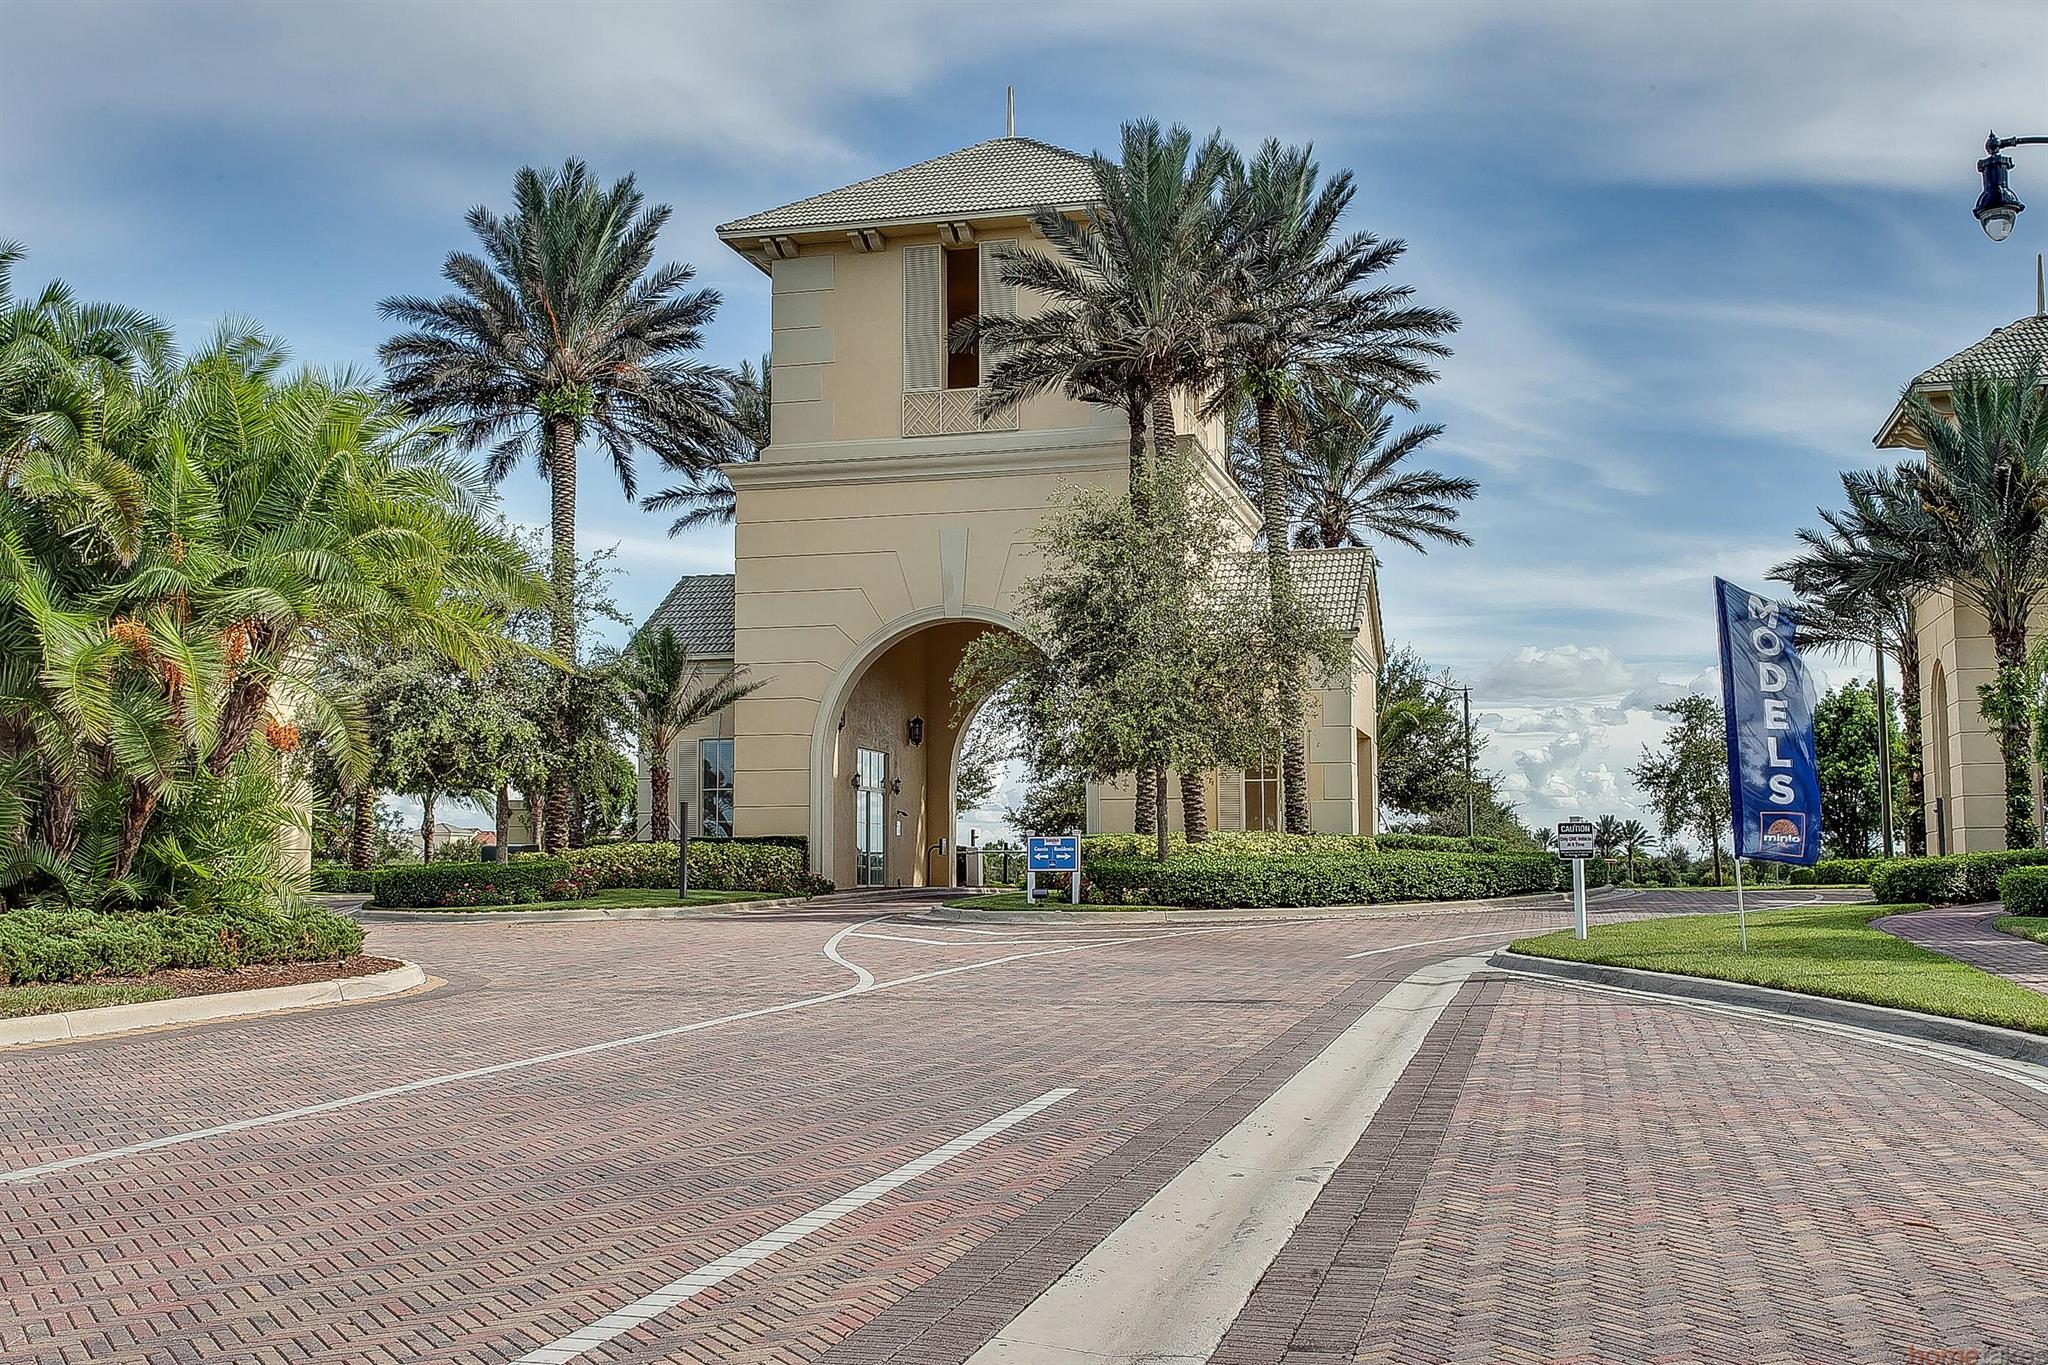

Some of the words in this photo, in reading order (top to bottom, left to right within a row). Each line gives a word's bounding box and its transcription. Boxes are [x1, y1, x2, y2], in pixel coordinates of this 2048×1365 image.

[1748, 594, 1795, 805] MODELS
[1560, 825, 1590, 833] CAUTION
[1763, 833, 1801, 843] minto
